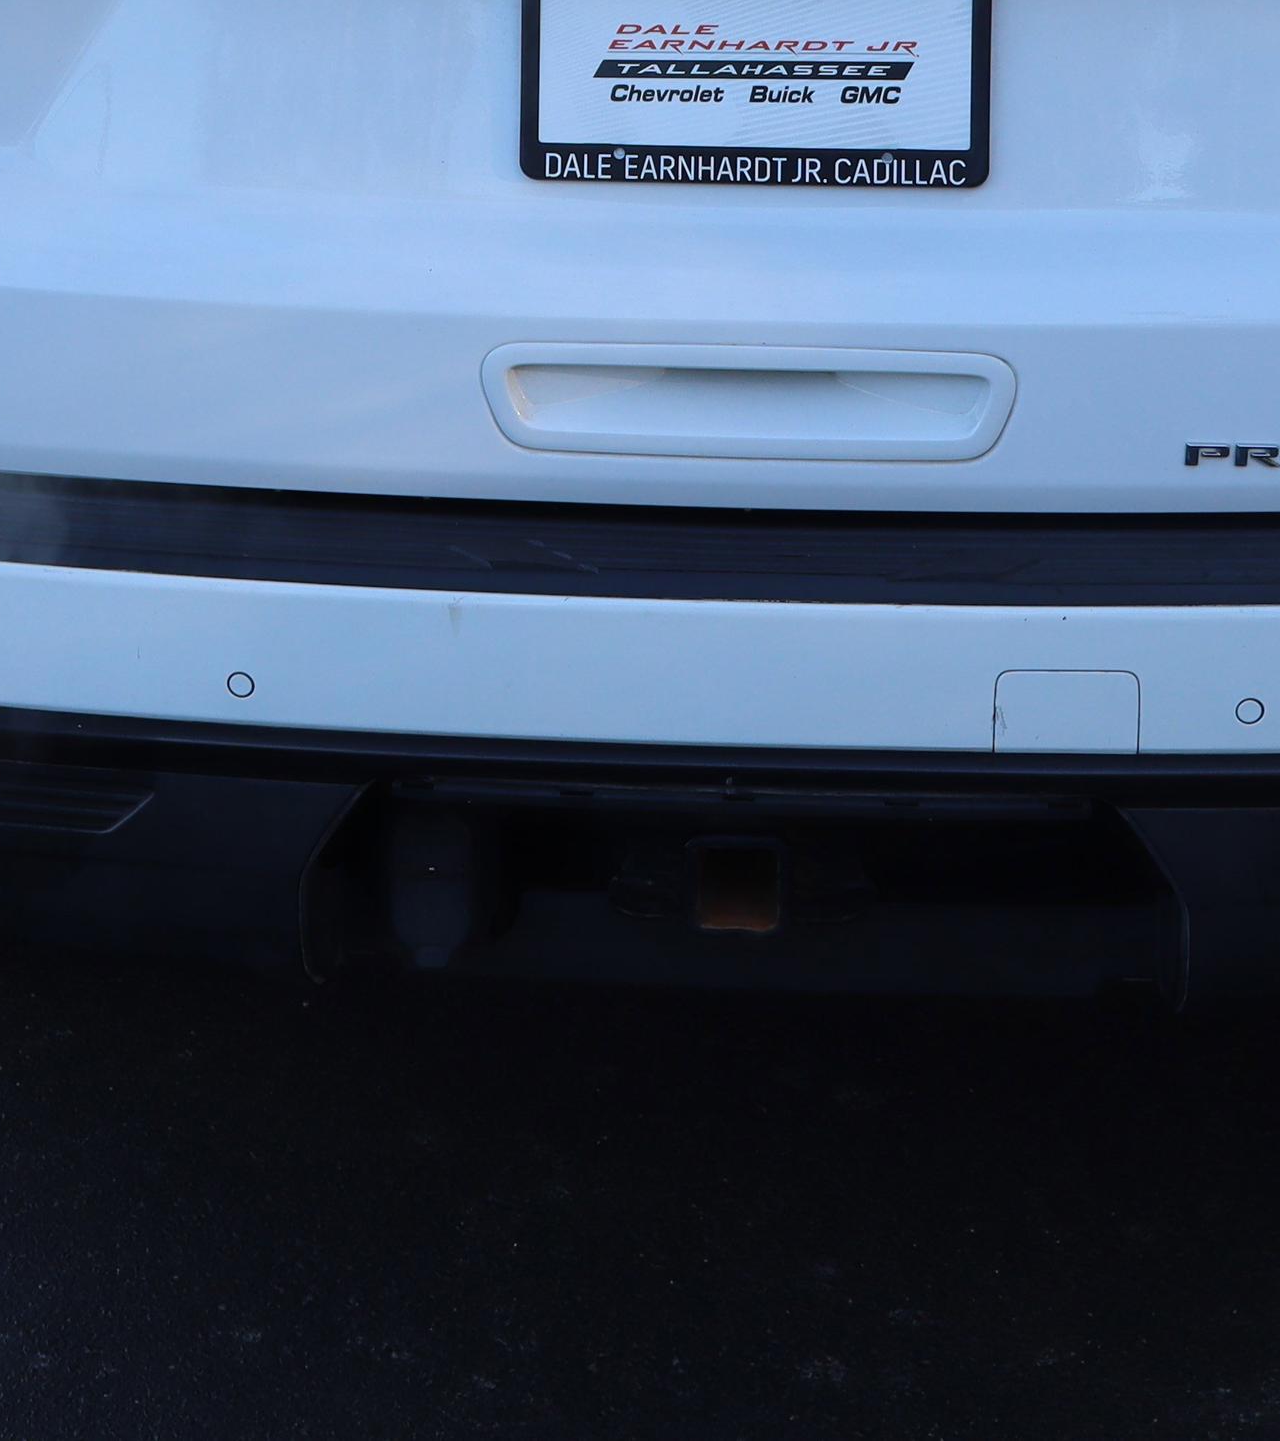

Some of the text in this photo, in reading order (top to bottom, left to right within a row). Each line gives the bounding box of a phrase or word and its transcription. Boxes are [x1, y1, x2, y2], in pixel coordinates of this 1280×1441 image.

[616, 24, 719, 35] DALE
[608, 39, 855, 55] EARNHARDT
[617, 63, 892, 77] TALLAHASSEE
[610, 84, 902, 105] Chevrolet Buick GMC
[545, 152, 967, 186] DALE EARNHARDT JR. CADILLAC
